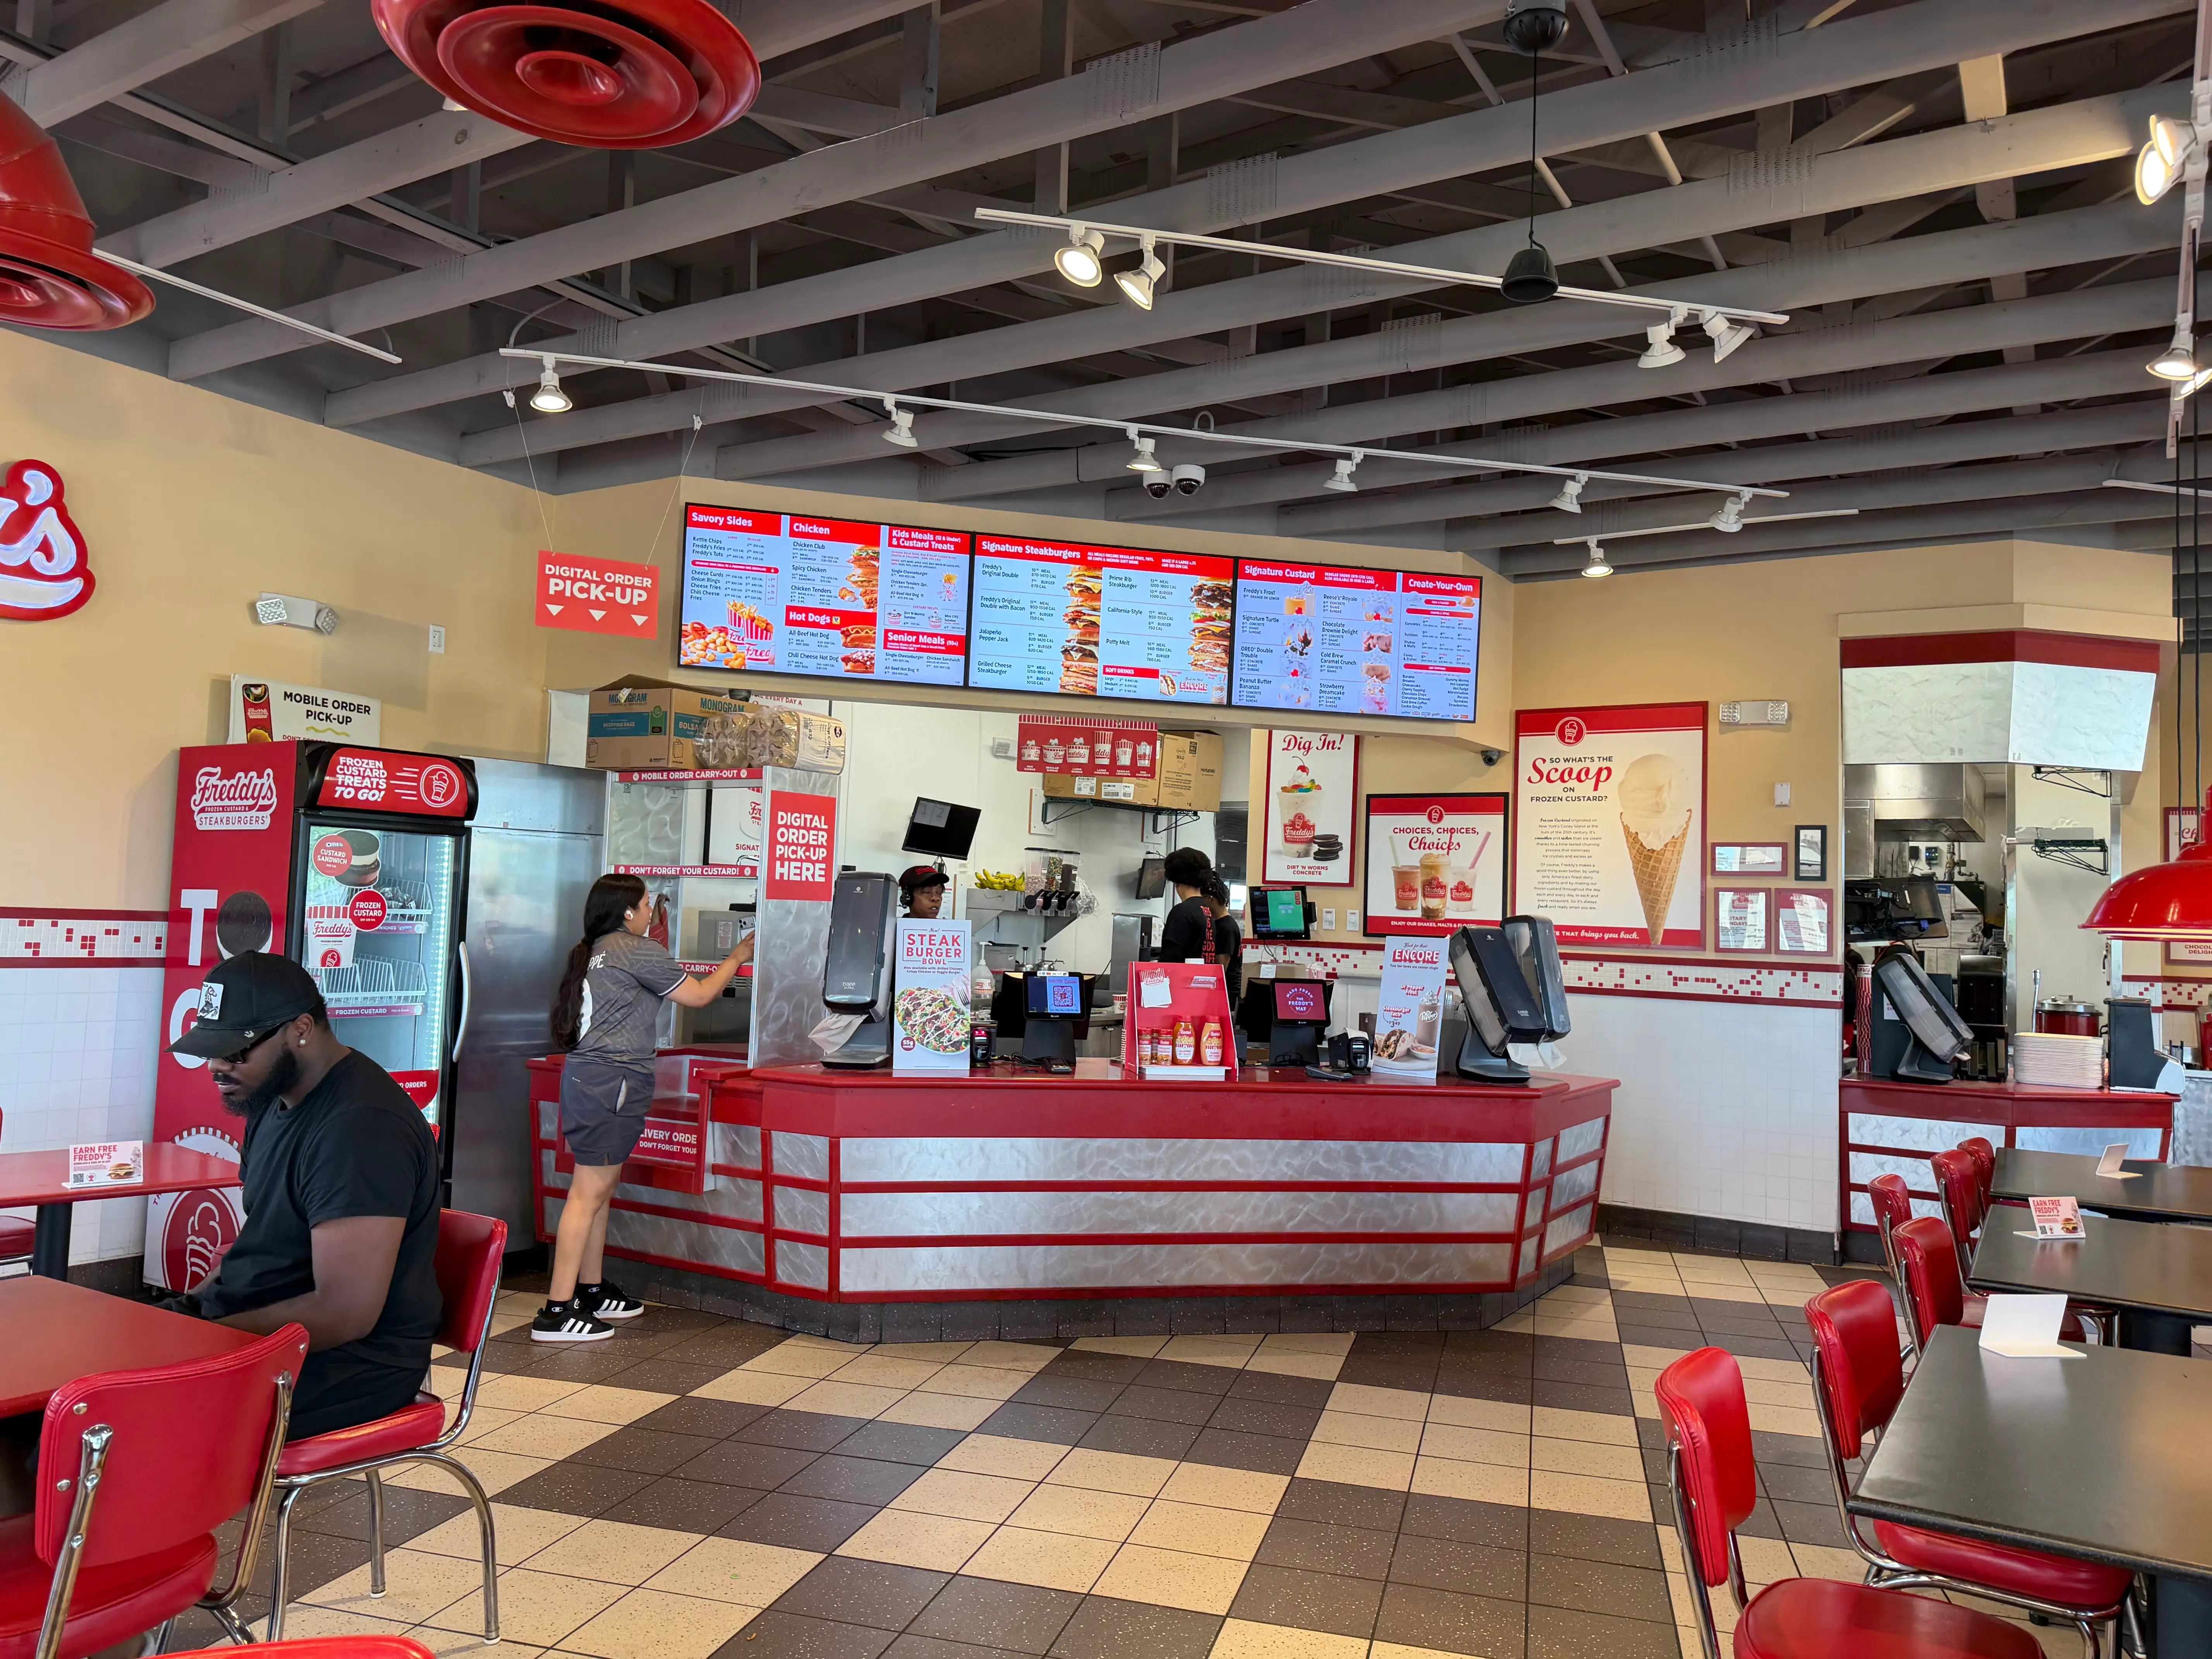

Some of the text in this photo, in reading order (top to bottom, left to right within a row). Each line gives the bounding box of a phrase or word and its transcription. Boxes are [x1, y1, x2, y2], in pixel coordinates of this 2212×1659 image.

[692, 513, 752, 527] Savory Sides
[793, 523, 830, 535] Chicken
[892, 530, 934, 540] Kids Meals
[900, 539, 929, 548] Custard
[931, 541, 954, 550] Treats
[982, 541, 1080, 559] Signature Steakburgers
[545, 564, 651, 587] DIGITAL ORDER
[1245, 565, 1315, 579] Signature Custard
[1409, 579, 1473, 591] Create-Your-Own
[549, 579, 647, 605] PICK-UP
[790, 611, 830, 624] Hot Dogs
[1108, 607, 1142, 615] California-Style
[888, 632, 945, 644] Senior Meals
[284, 691, 370, 715] MOBILE ORDER
[700, 698, 744, 713] MONOGRAM
[306, 710, 352, 725] PICK-UP
[1282, 734, 1344, 756] Dig In!
[340, 757, 383, 768] FROZEN
[336, 765, 387, 778] CUSTARD
[1527, 757, 1612, 792] Scoop
[194, 768, 275, 802] Freddy's
[337, 776, 386, 788] TREATS
[335, 788, 385, 801] TO GO!
[778, 812, 828, 829] DIGITAL
[777, 828, 827, 845] ORDER
[1285, 827, 1314, 836] Freddy's
[1437, 827, 1479, 835] CHOICES,
[1408, 836, 1461, 851] Choices
[321, 849, 345, 857] CUSTARD
[776, 845, 826, 859] PICK-UP
[317, 855, 347, 864] SANDWICH
[775, 862, 826, 881] HERE
[354, 909, 382, 917] CUSTARD
[180, 890, 217, 965] T
[312, 921, 352, 938] Freddy's
[907, 934, 961, 946] STEAK
[1580, 930, 1602, 939] brings
[1604, 931, 1618, 939] you
[1620, 931, 1639, 939] back.
[907, 947, 961, 957] BURGER
[1394, 950, 1439, 963] ENCORE
[658, 1144, 680, 1152] FORGET
[74, 1152, 112, 1161] FREDDY'S
